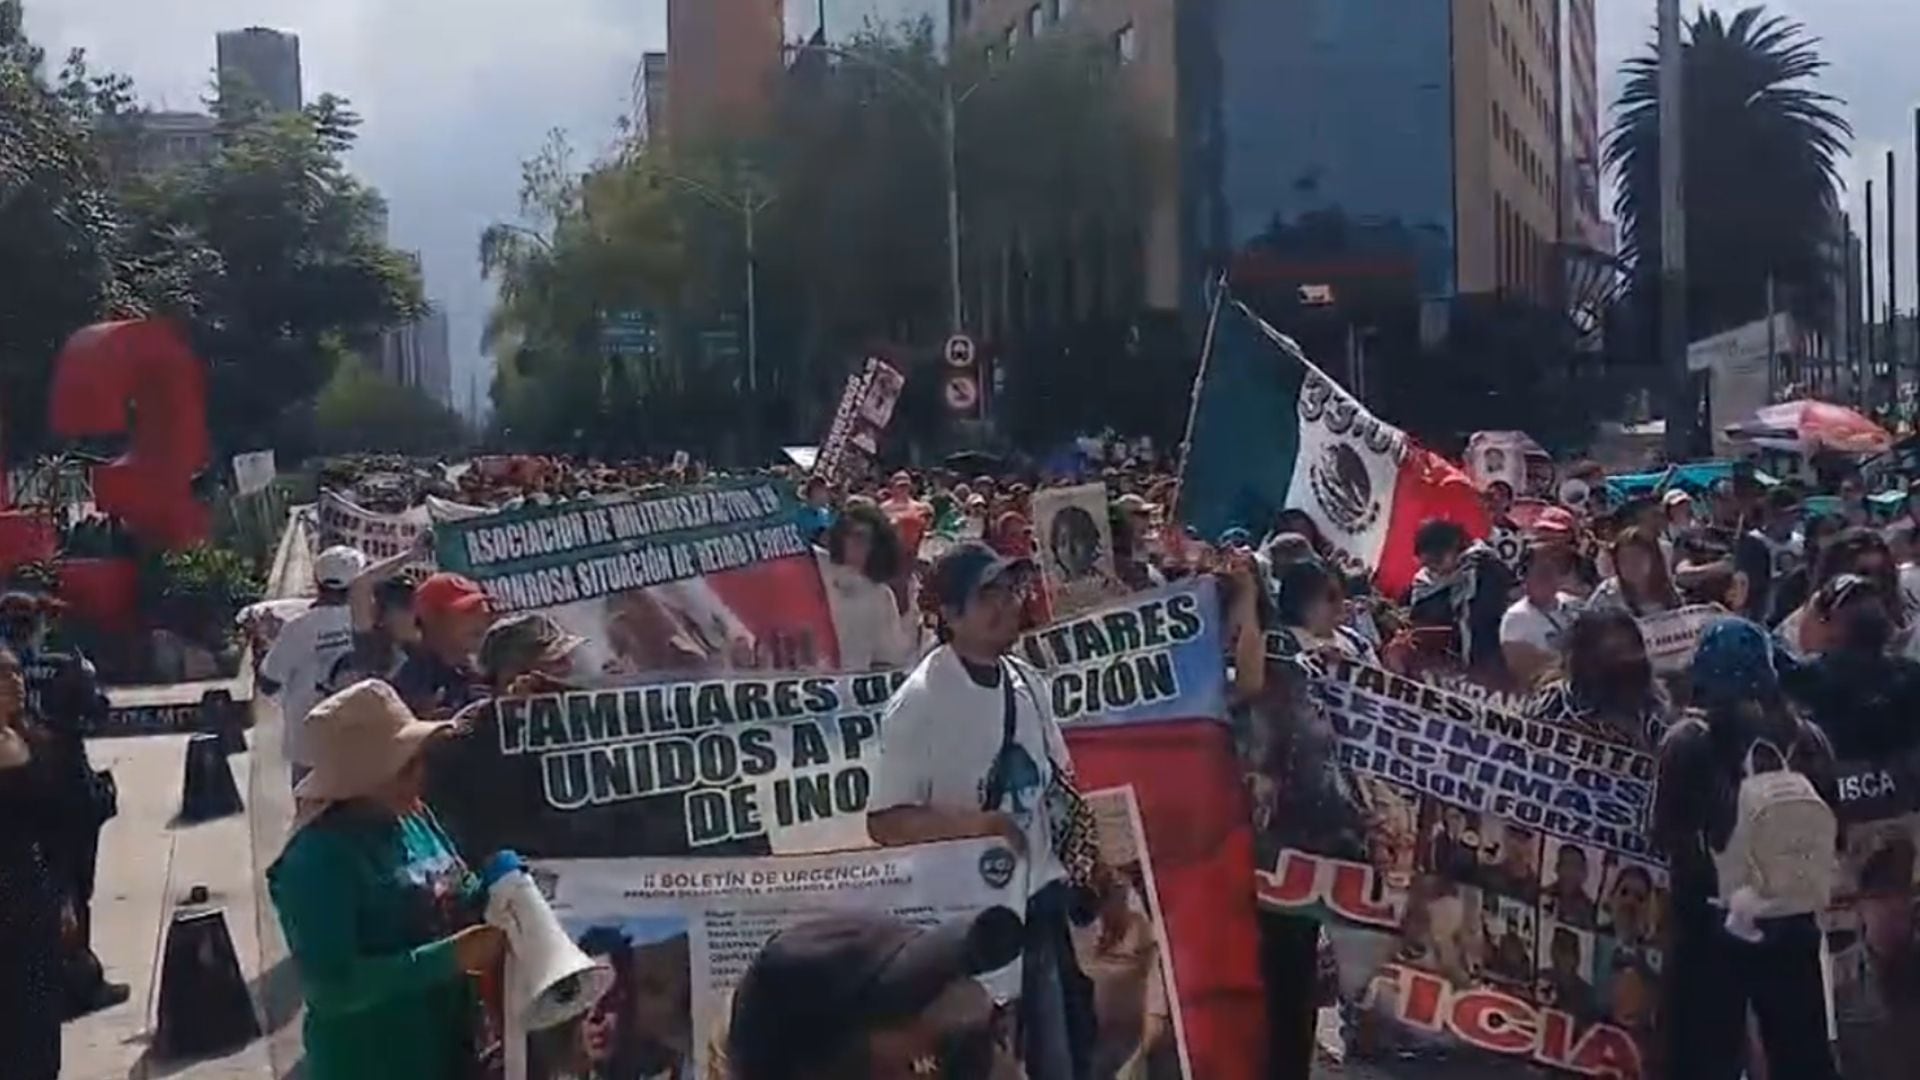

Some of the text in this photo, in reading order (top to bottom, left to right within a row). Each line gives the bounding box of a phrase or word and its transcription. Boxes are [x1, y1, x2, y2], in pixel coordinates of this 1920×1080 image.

[585, 508, 613, 543] DE
[575, 541, 674, 598] SITUACIÓN
[670, 543, 695, 578] DE
[499, 676, 841, 754] FAMILIARES
[1021, 592, 1203, 670] ITARES
[1051, 651, 1181, 721] CIÓN
[544, 712, 883, 809] UNIDOS A P
[686, 766, 871, 848] DE INO
[660, 870, 747, 889] BOLETÍN
[751, 869, 778, 887] DE
[783, 864, 880, 884] URGENCIA
